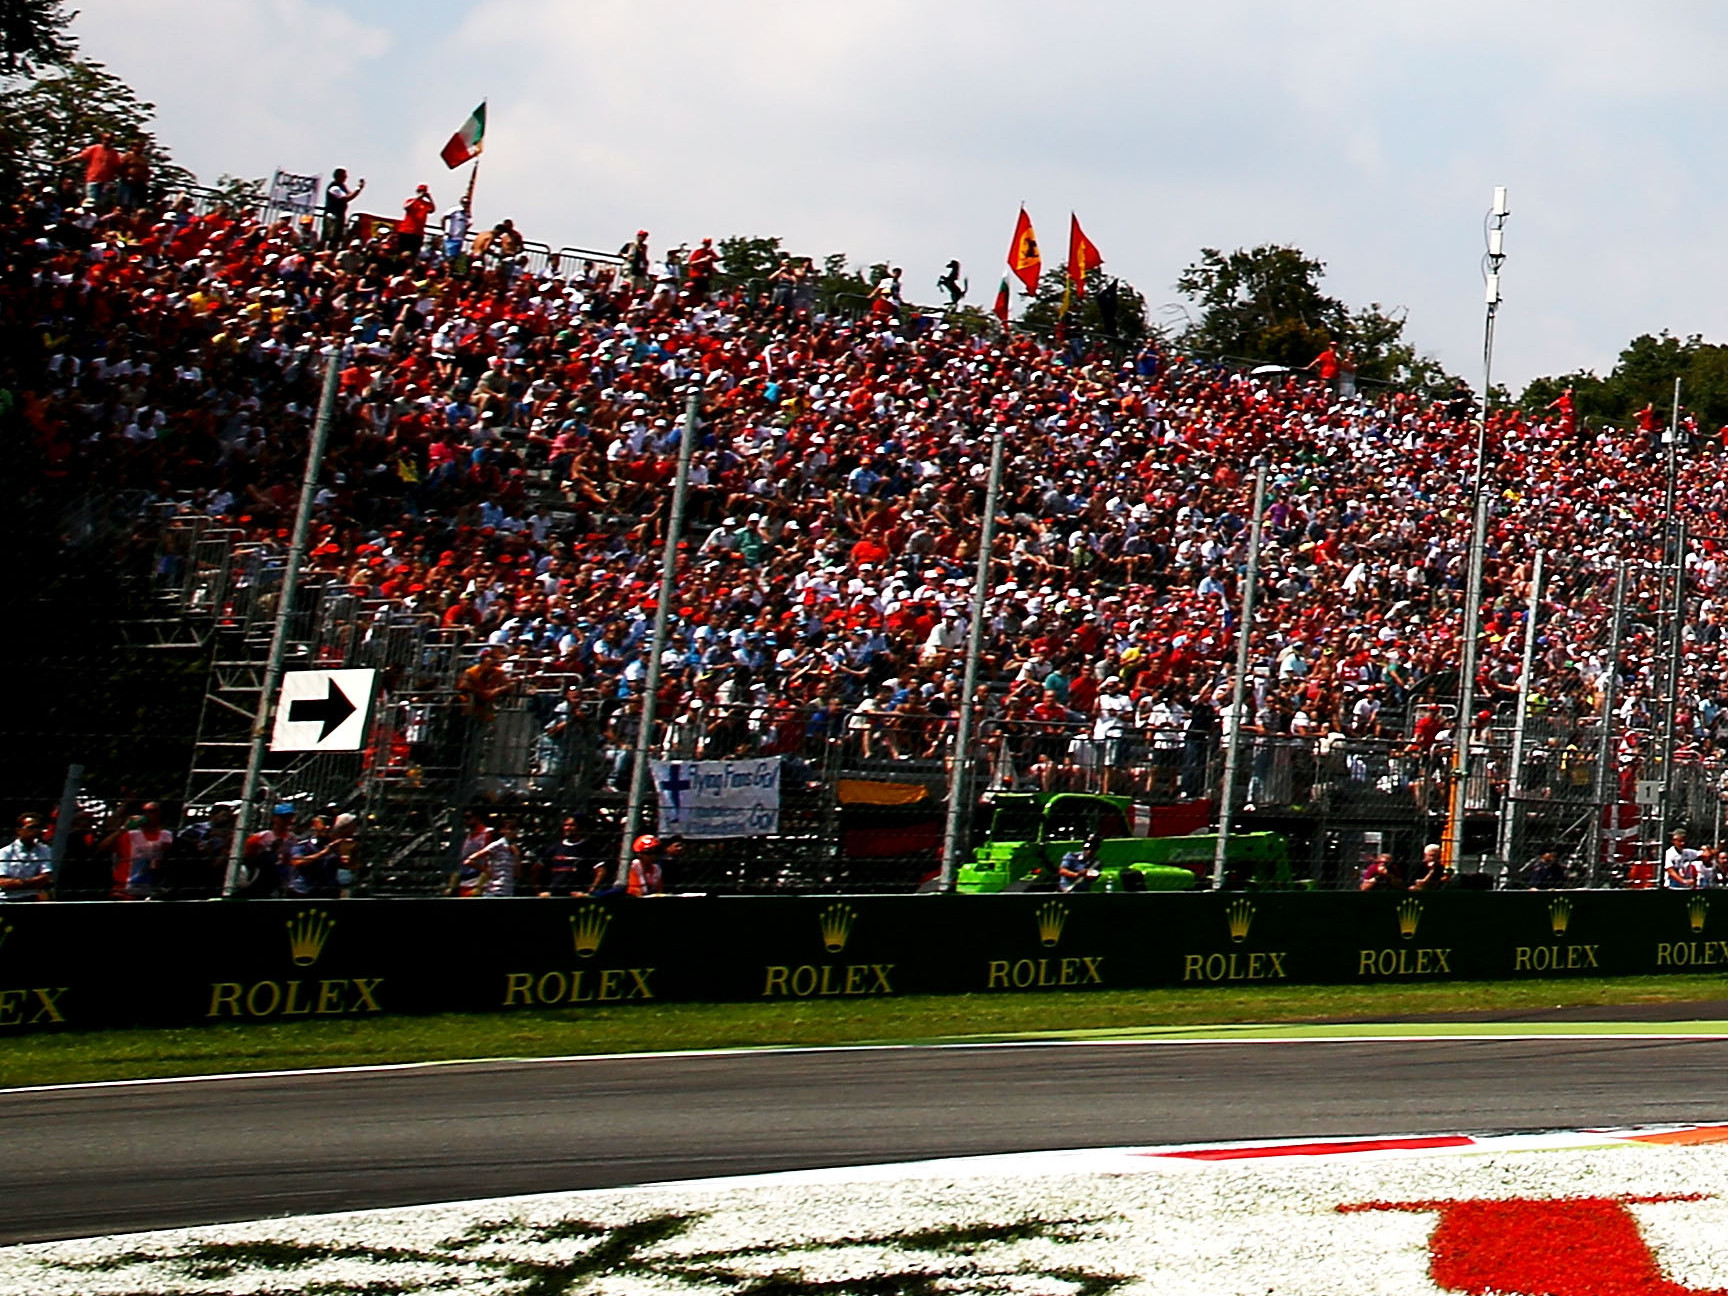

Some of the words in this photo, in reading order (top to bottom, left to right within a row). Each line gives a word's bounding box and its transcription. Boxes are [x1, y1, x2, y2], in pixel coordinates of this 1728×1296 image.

[1645, 785, 1651, 798] 1
[987, 956, 1103, 988] ROLEX
[1183, 952, 1287, 981] ROLEX
[1358, 948, 1452, 975] ROLEX
[1514, 945, 1599, 971] ROLEX
[502, 968, 655, 1006] ROLEX
[761, 964, 895, 997] ROLEX
[205, 978, 384, 1017] ROLEX
